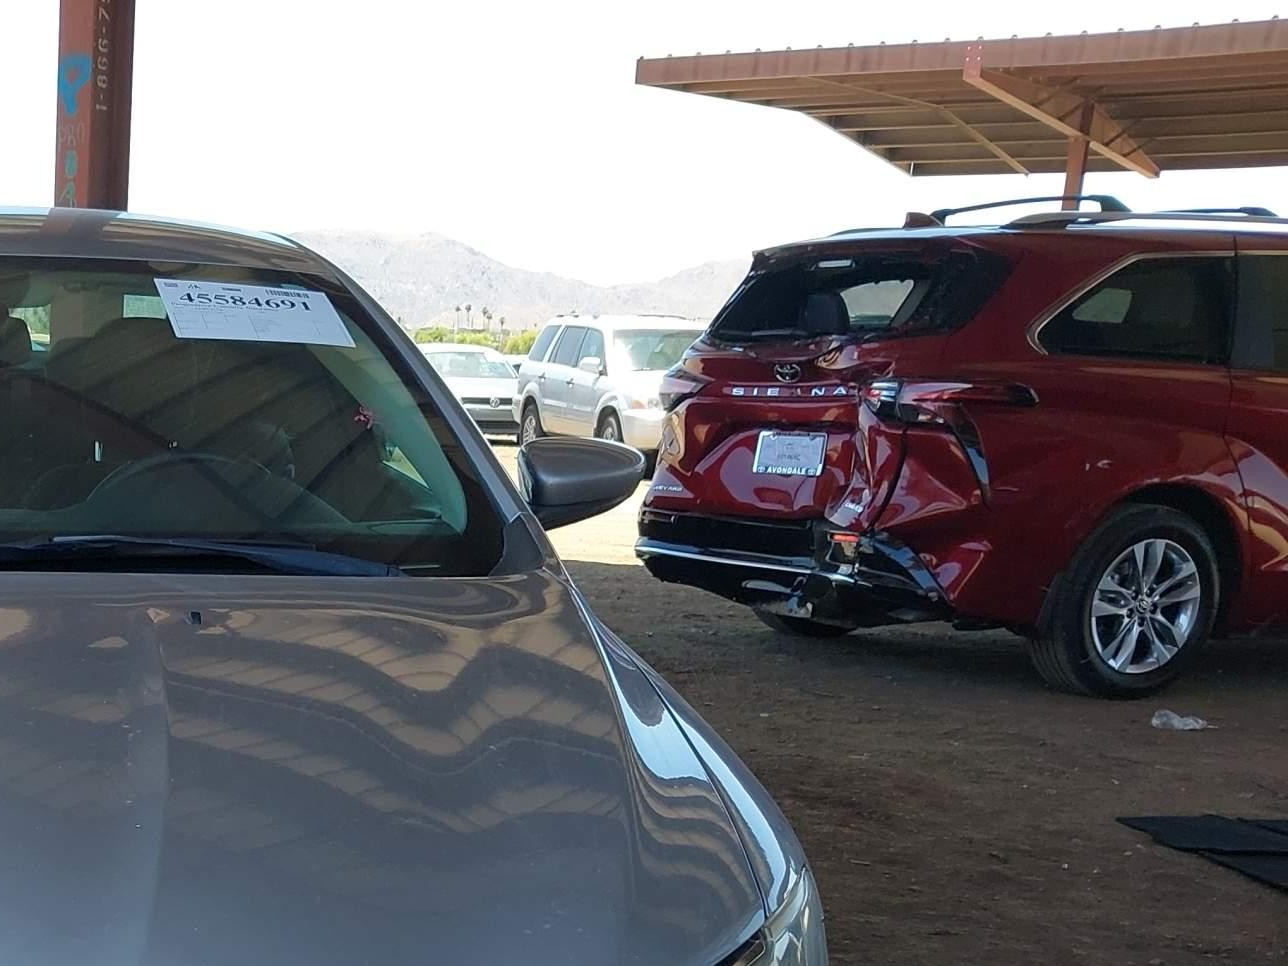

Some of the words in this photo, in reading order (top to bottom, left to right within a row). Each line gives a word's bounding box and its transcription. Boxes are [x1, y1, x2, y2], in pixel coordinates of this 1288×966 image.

[96, 0, 110, 111] 1-866-7
[179, 292, 312, 312] 45584691
[766, 465, 807, 475] AVONDALE
